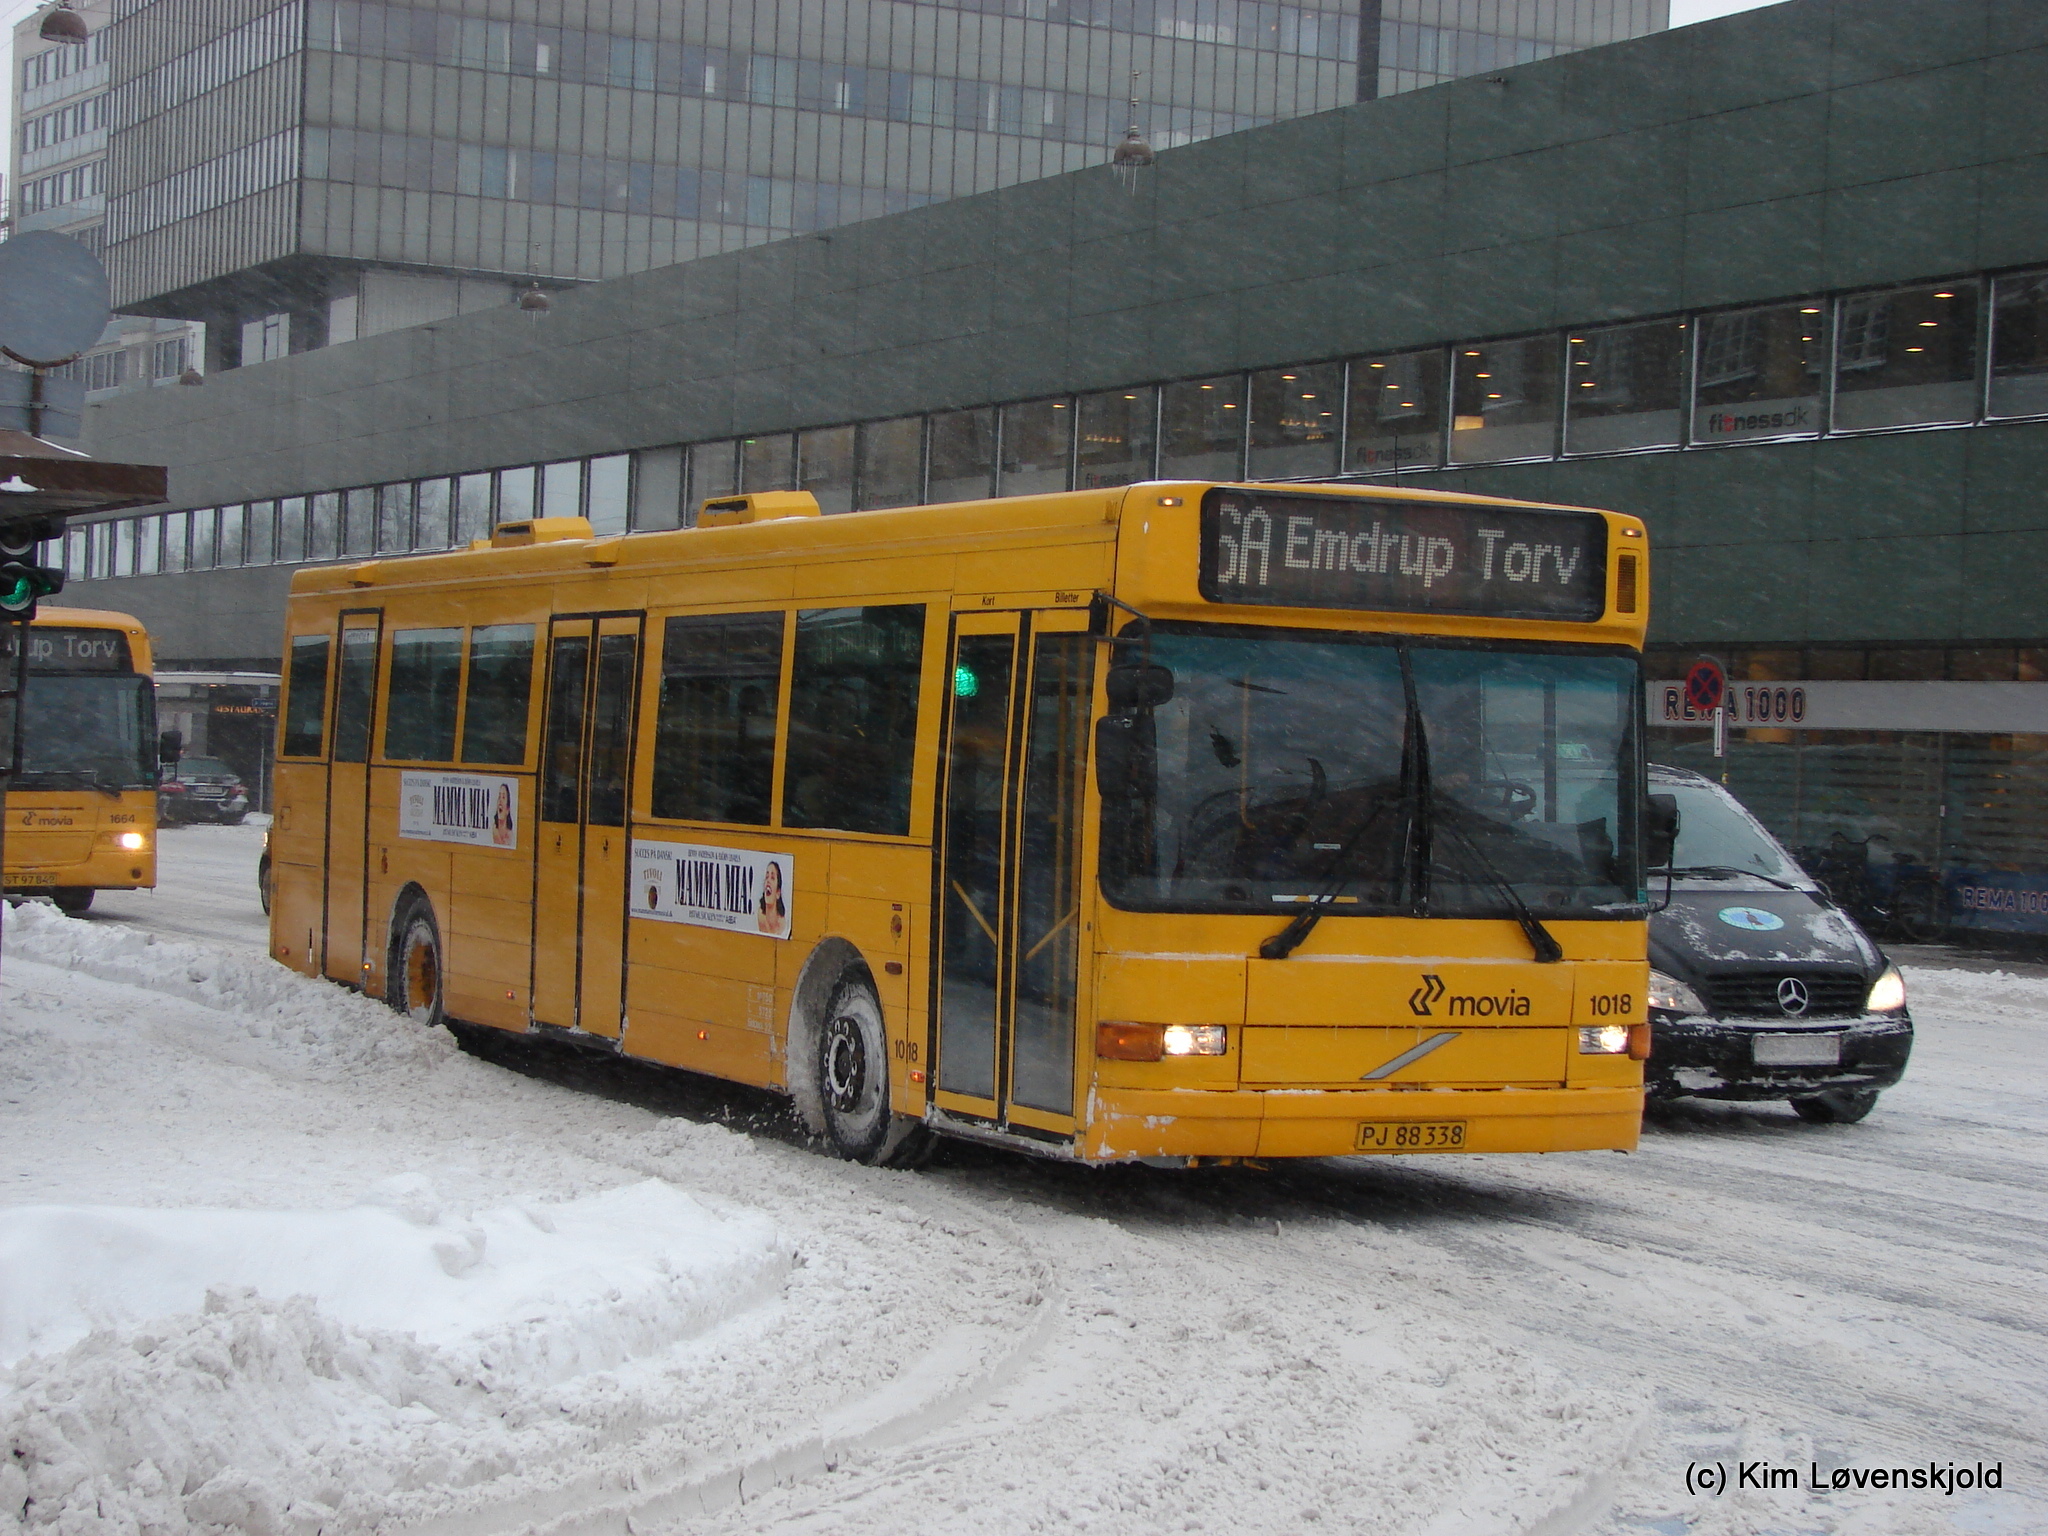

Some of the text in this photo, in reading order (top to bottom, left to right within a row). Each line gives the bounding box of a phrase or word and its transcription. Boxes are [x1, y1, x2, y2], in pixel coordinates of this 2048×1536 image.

[1285, 515, 1454, 587] Emdrup
[1478, 529, 1580, 584] Torv
[63, 635, 116, 658] Torv
[1744, 687, 1806, 722] 1000
[110, 814, 135, 824] 1664
[433, 785, 490, 829] MAMMA MIA!
[38, 815, 73, 826] movia
[675, 858, 754, 915] MAMMA MIA!
[1962, 886, 2017, 911] REMA
[1449, 988, 1531, 1016] movia
[1590, 993, 1632, 1015] 1018
[894, 1038, 919, 1062] 1018
[1362, 1125, 1463, 1146] PJ 88 338
